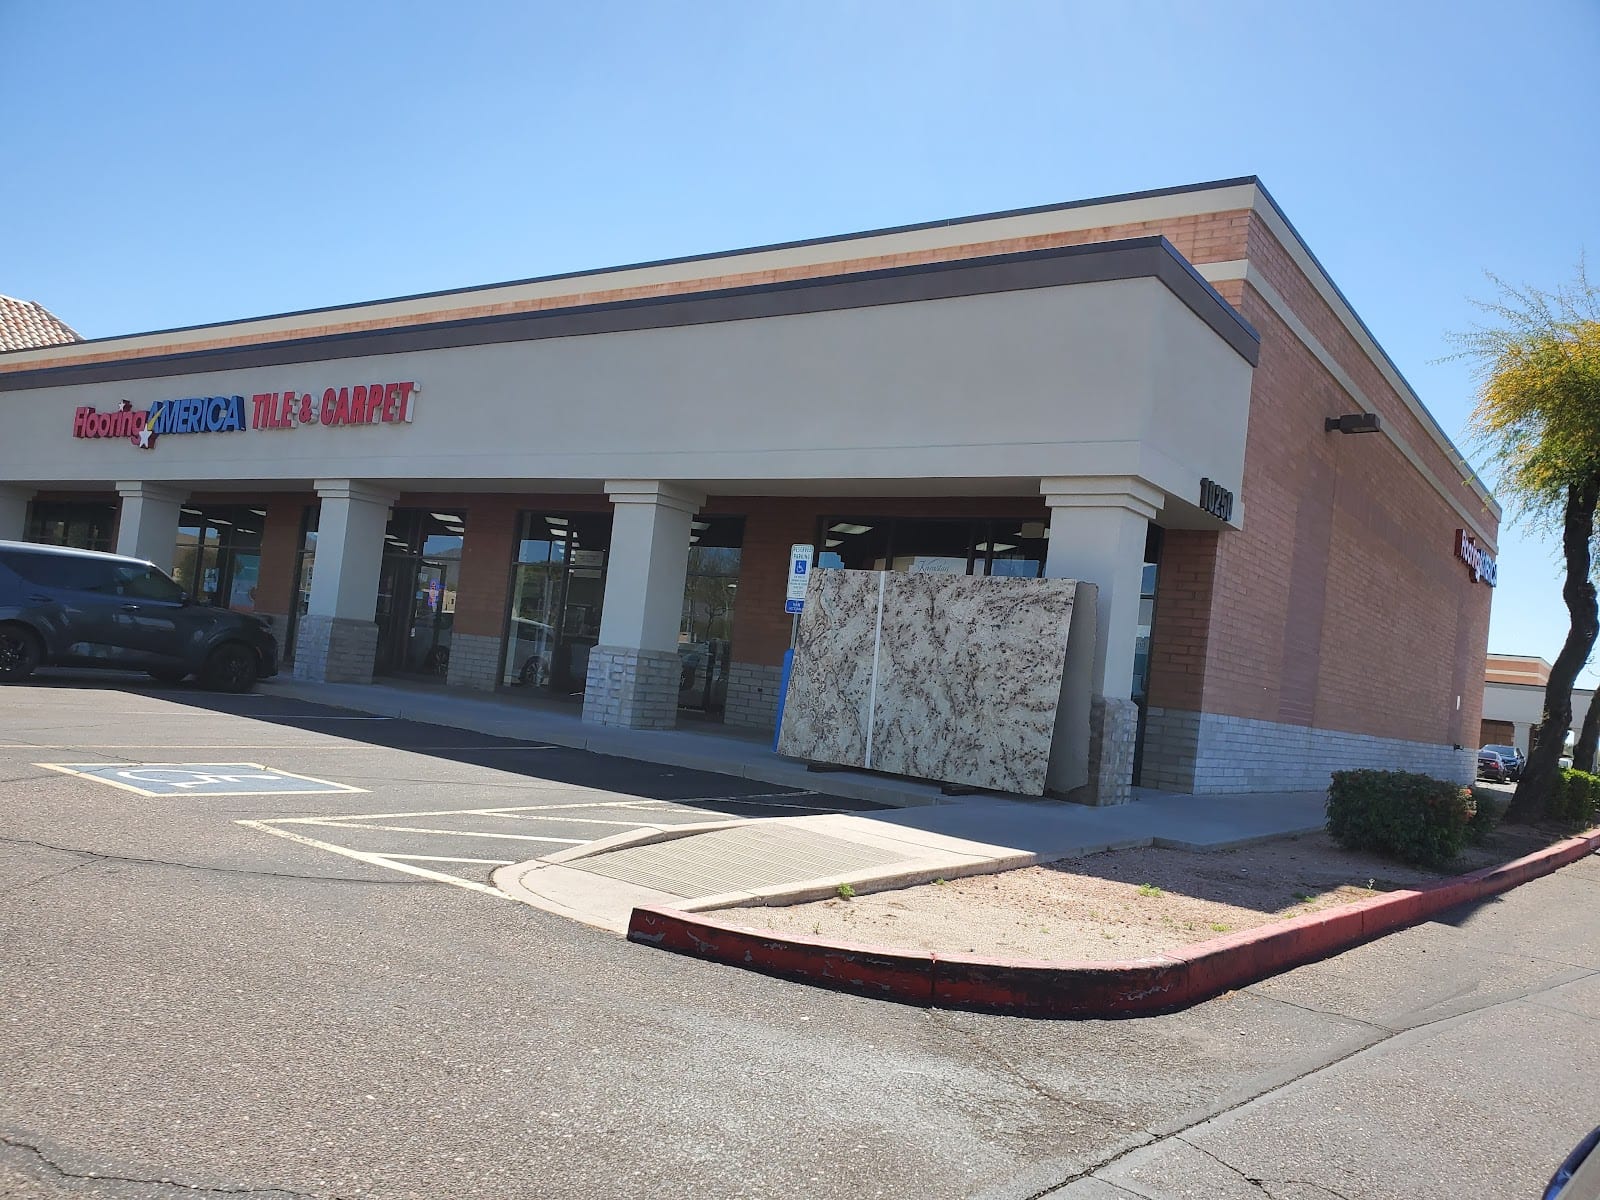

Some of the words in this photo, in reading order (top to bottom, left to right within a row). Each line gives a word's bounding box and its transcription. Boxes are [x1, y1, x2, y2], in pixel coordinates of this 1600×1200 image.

[73, 406, 148, 446] Flooring
[148, 396, 241, 434] AMERICA
[252, 391, 296, 430] TILE
[299, 393, 313, 424] &
[320, 381, 415, 426] CARPET
